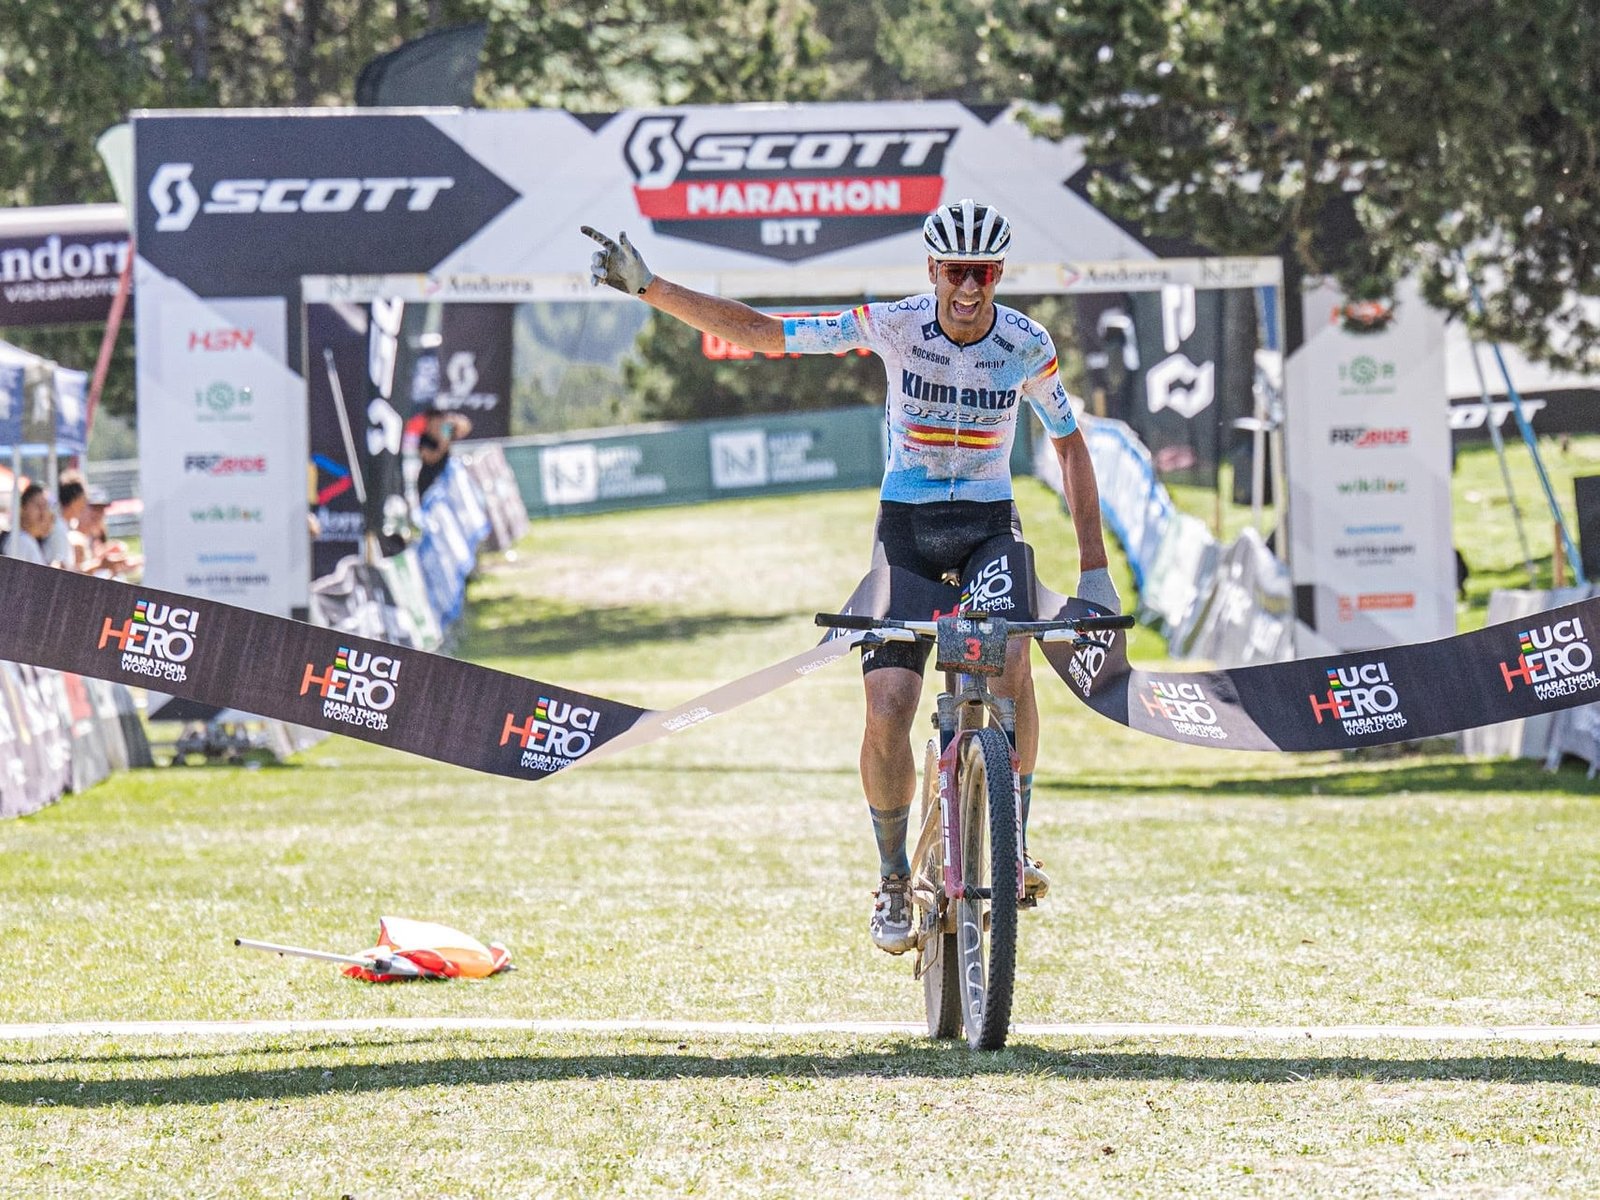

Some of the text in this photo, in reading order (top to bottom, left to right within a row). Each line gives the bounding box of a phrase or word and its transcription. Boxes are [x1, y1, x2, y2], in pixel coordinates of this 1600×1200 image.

[684, 132, 950, 172] SCOTT
[203, 176, 455, 214] SCOTT
[686, 181, 901, 215] MARATHON
[760, 218, 822, 246] BTT
[0, 233, 130, 282] ndorr
[911, 344, 951, 366] ROCKSHOX
[901, 367, 1017, 410] Klimatiza
[1447, 398, 1548, 430] OTT
[969, 555, 1010, 594] UCI
[146, 602, 200, 633] UCI
[1529, 617, 1585, 649] UCI
[98, 617, 195, 663] HERO
[963, 637, 983, 662] 3
[121, 653, 187, 675] MARATHON
[121, 661, 188, 682] WORLD CUP
[347, 649, 402, 682] UCI
[1337, 662, 1390, 688] UCI
[1499, 642, 1593, 693] HERO
[300, 663, 396, 711] HERO
[1157, 681, 1207, 701] UCI
[1534, 670, 1597, 693] MARATHON
[1535, 678, 1600, 701] WORLD CUP
[323, 700, 388, 723] MARATHON
[323, 708, 389, 732] WORLD CUP
[547, 699, 600, 732] UCI
[1139, 693, 1218, 725] HERO
[1309, 684, 1399, 725] HERO
[1342, 712, 1403, 729] MARATHON
[499, 712, 592, 759] HERO
[1345, 718, 1408, 737] WORLD CUP
[520, 758, 557, 772] WORLD
